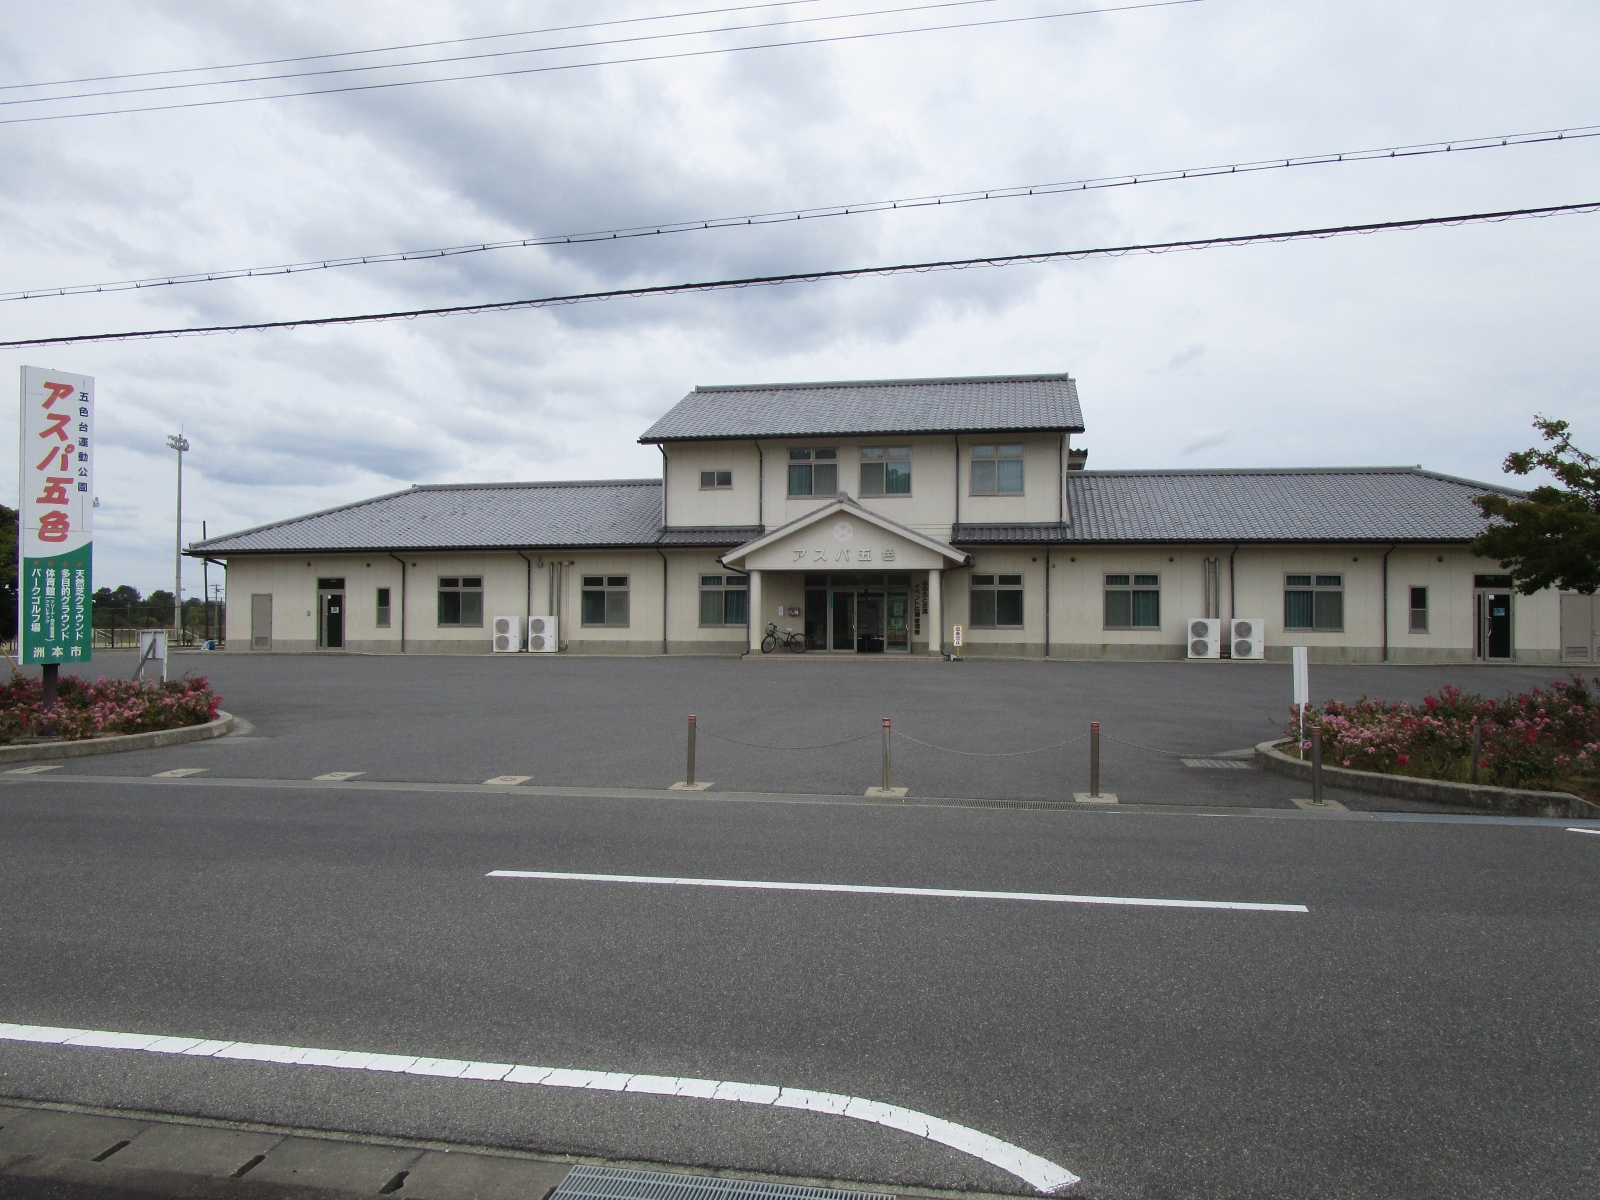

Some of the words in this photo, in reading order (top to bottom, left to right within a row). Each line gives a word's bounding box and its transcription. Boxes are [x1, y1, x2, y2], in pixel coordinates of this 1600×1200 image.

[36, 381, 76, 543] アスパ五色
[77, 391, 89, 493] 五色台運動公園
[793, 548, 895, 562] アスパ五色
[30, 568, 42, 633] パークゴルフ場
[61, 568, 71, 641] 多目的グラウンド
[75, 569, 85, 641] 天然芝グラウンド
[33, 646, 82, 658] 洲本市
